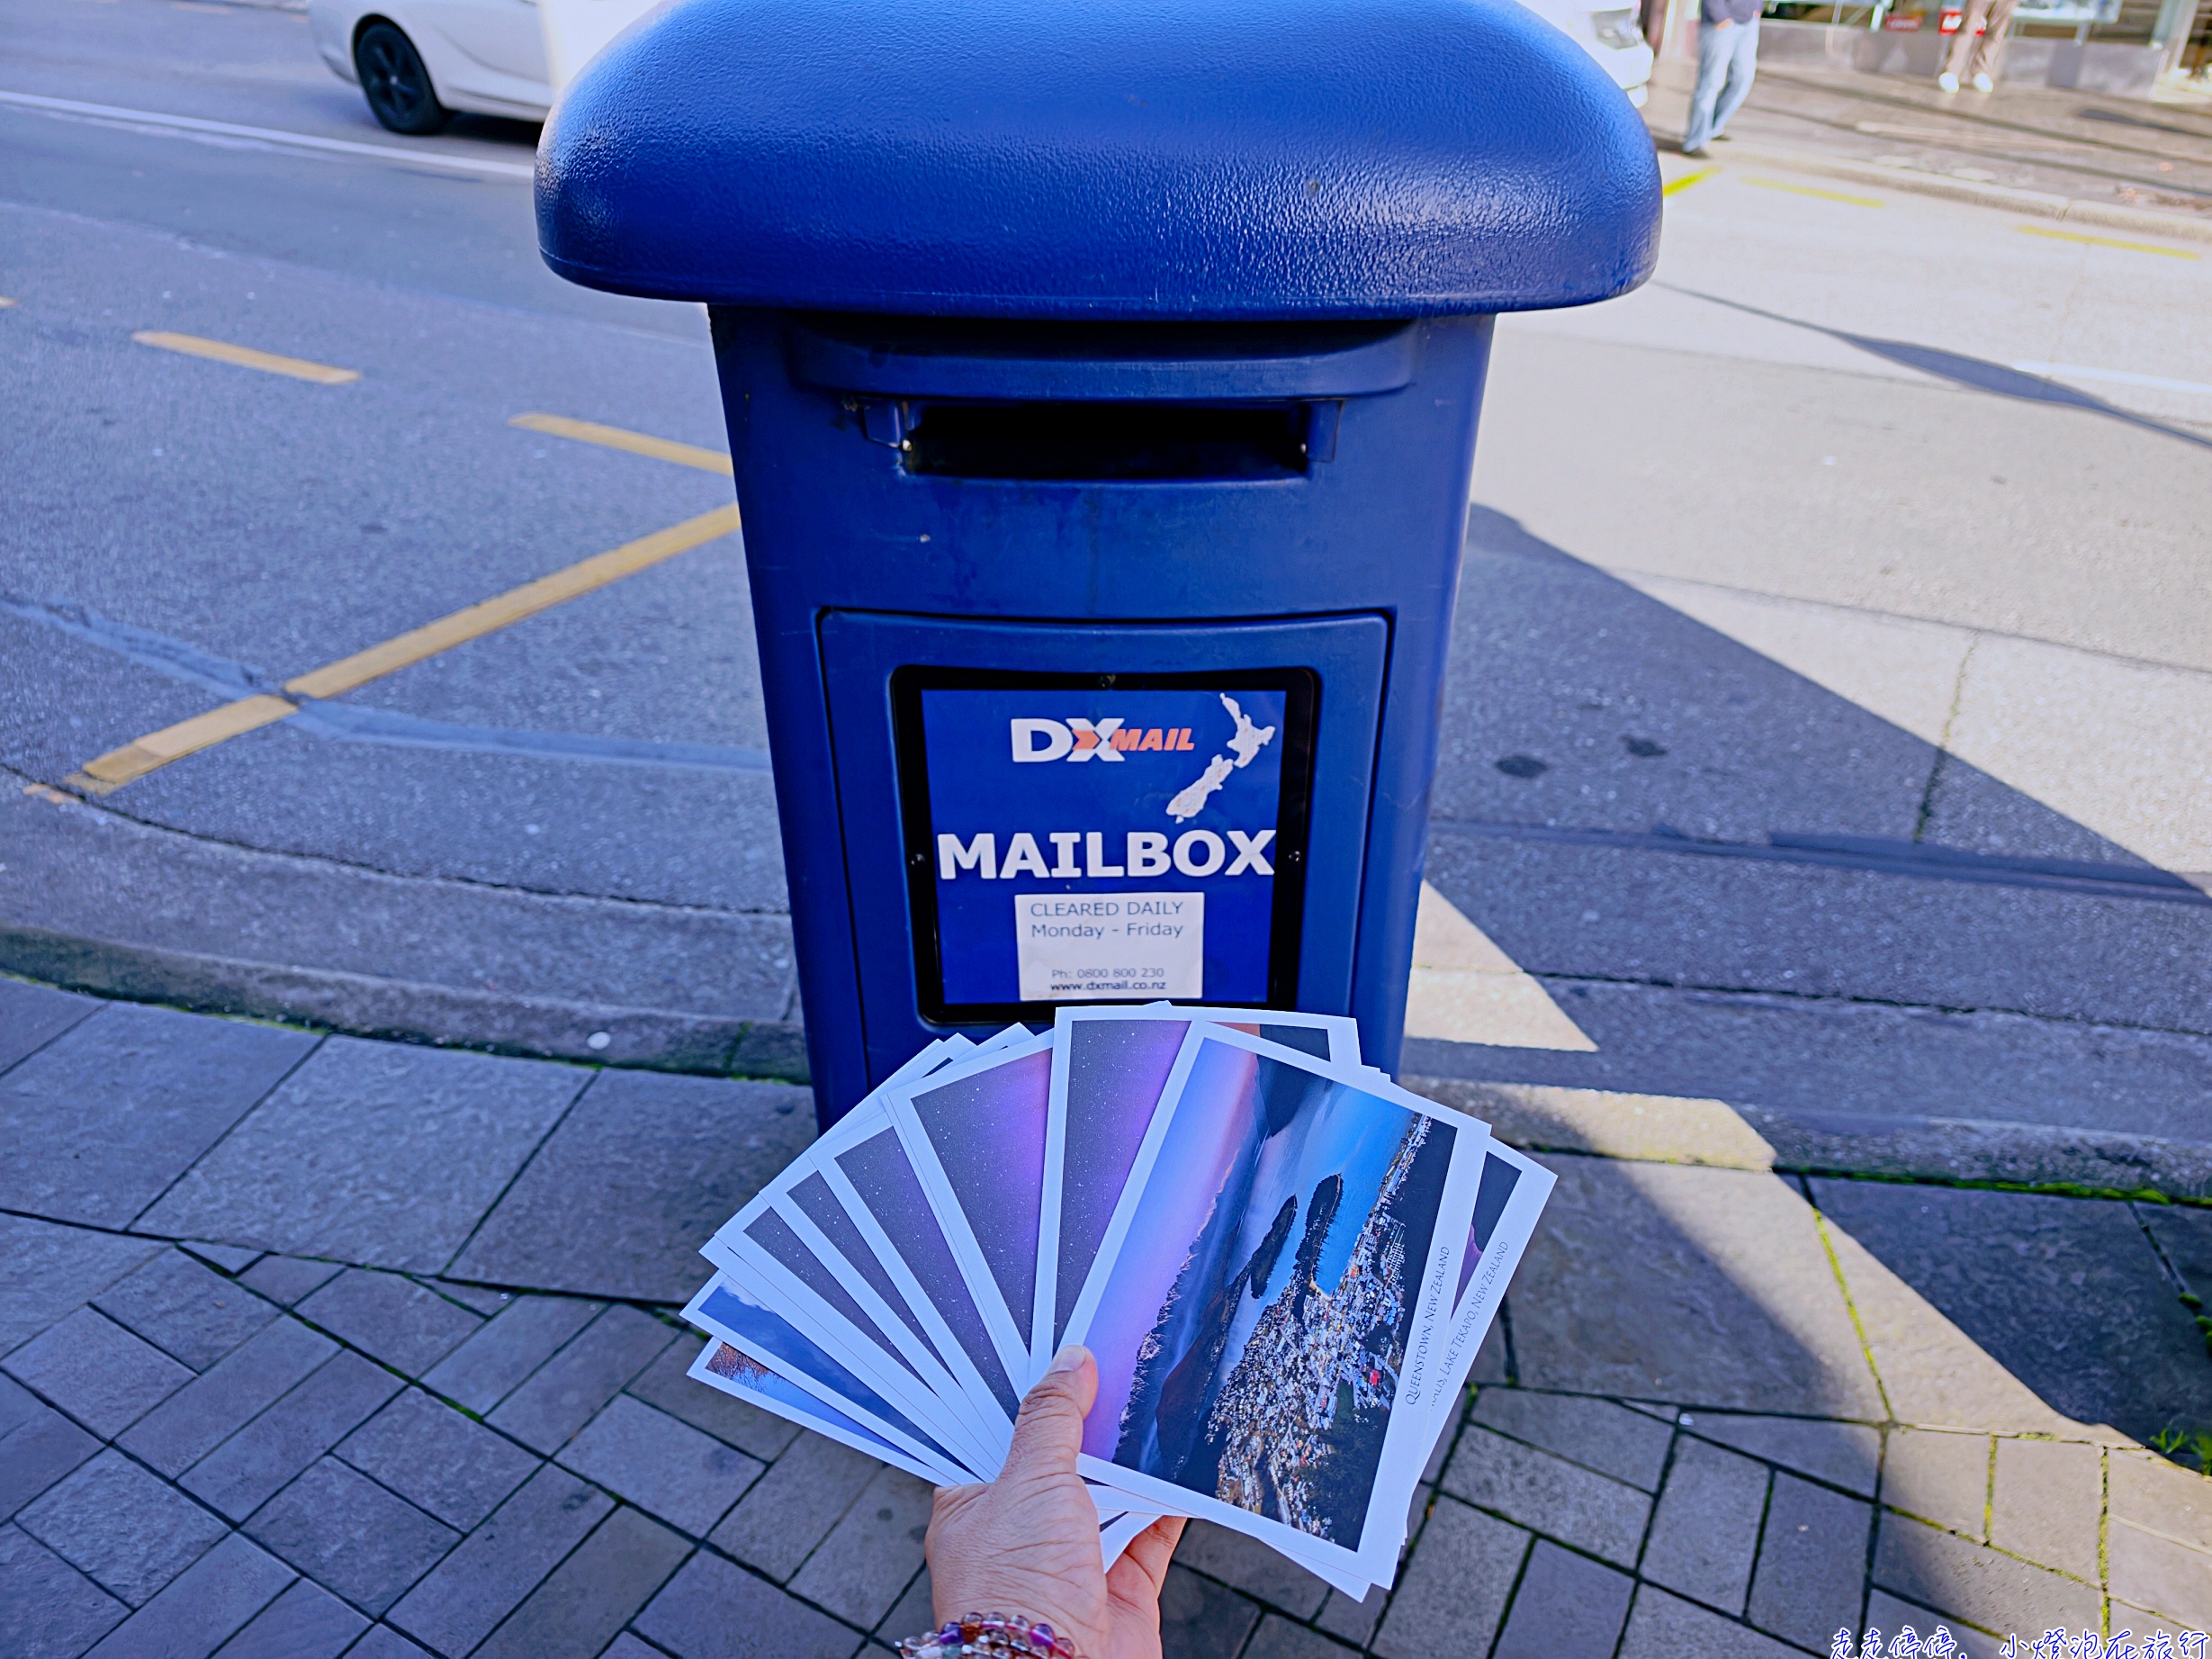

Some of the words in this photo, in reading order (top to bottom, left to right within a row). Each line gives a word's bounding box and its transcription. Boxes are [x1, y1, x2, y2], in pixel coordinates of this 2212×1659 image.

[937, 829, 1277, 879] MAILBOX
[1030, 903, 1119, 916] CLEARED
[1127, 901, 1183, 915] DAILY
[1031, 924, 1105, 939] Monday
[1127, 922, 1184, 938] Friday
[1050, 980, 1166, 991] www.dxmail.co.nz
[1052, 969, 1072, 978] Ph:
[1077, 969, 1108, 978] 0800
[1113, 968, 1137, 978] 800
[1141, 968, 1164, 978] 230
[1430, 1246, 1450, 1294] ZEALAND
[1425, 1294, 1438, 1322] NEW
[1439, 1348, 1458, 1375] LAKE
[1451, 1311, 1480, 1349] TEKAPO,
[1470, 1285, 1489, 1309] NEW
[1482, 1241, 1508, 1285] ZEALAND
[1405, 1325, 1434, 1405] QUEENSTOWN,
